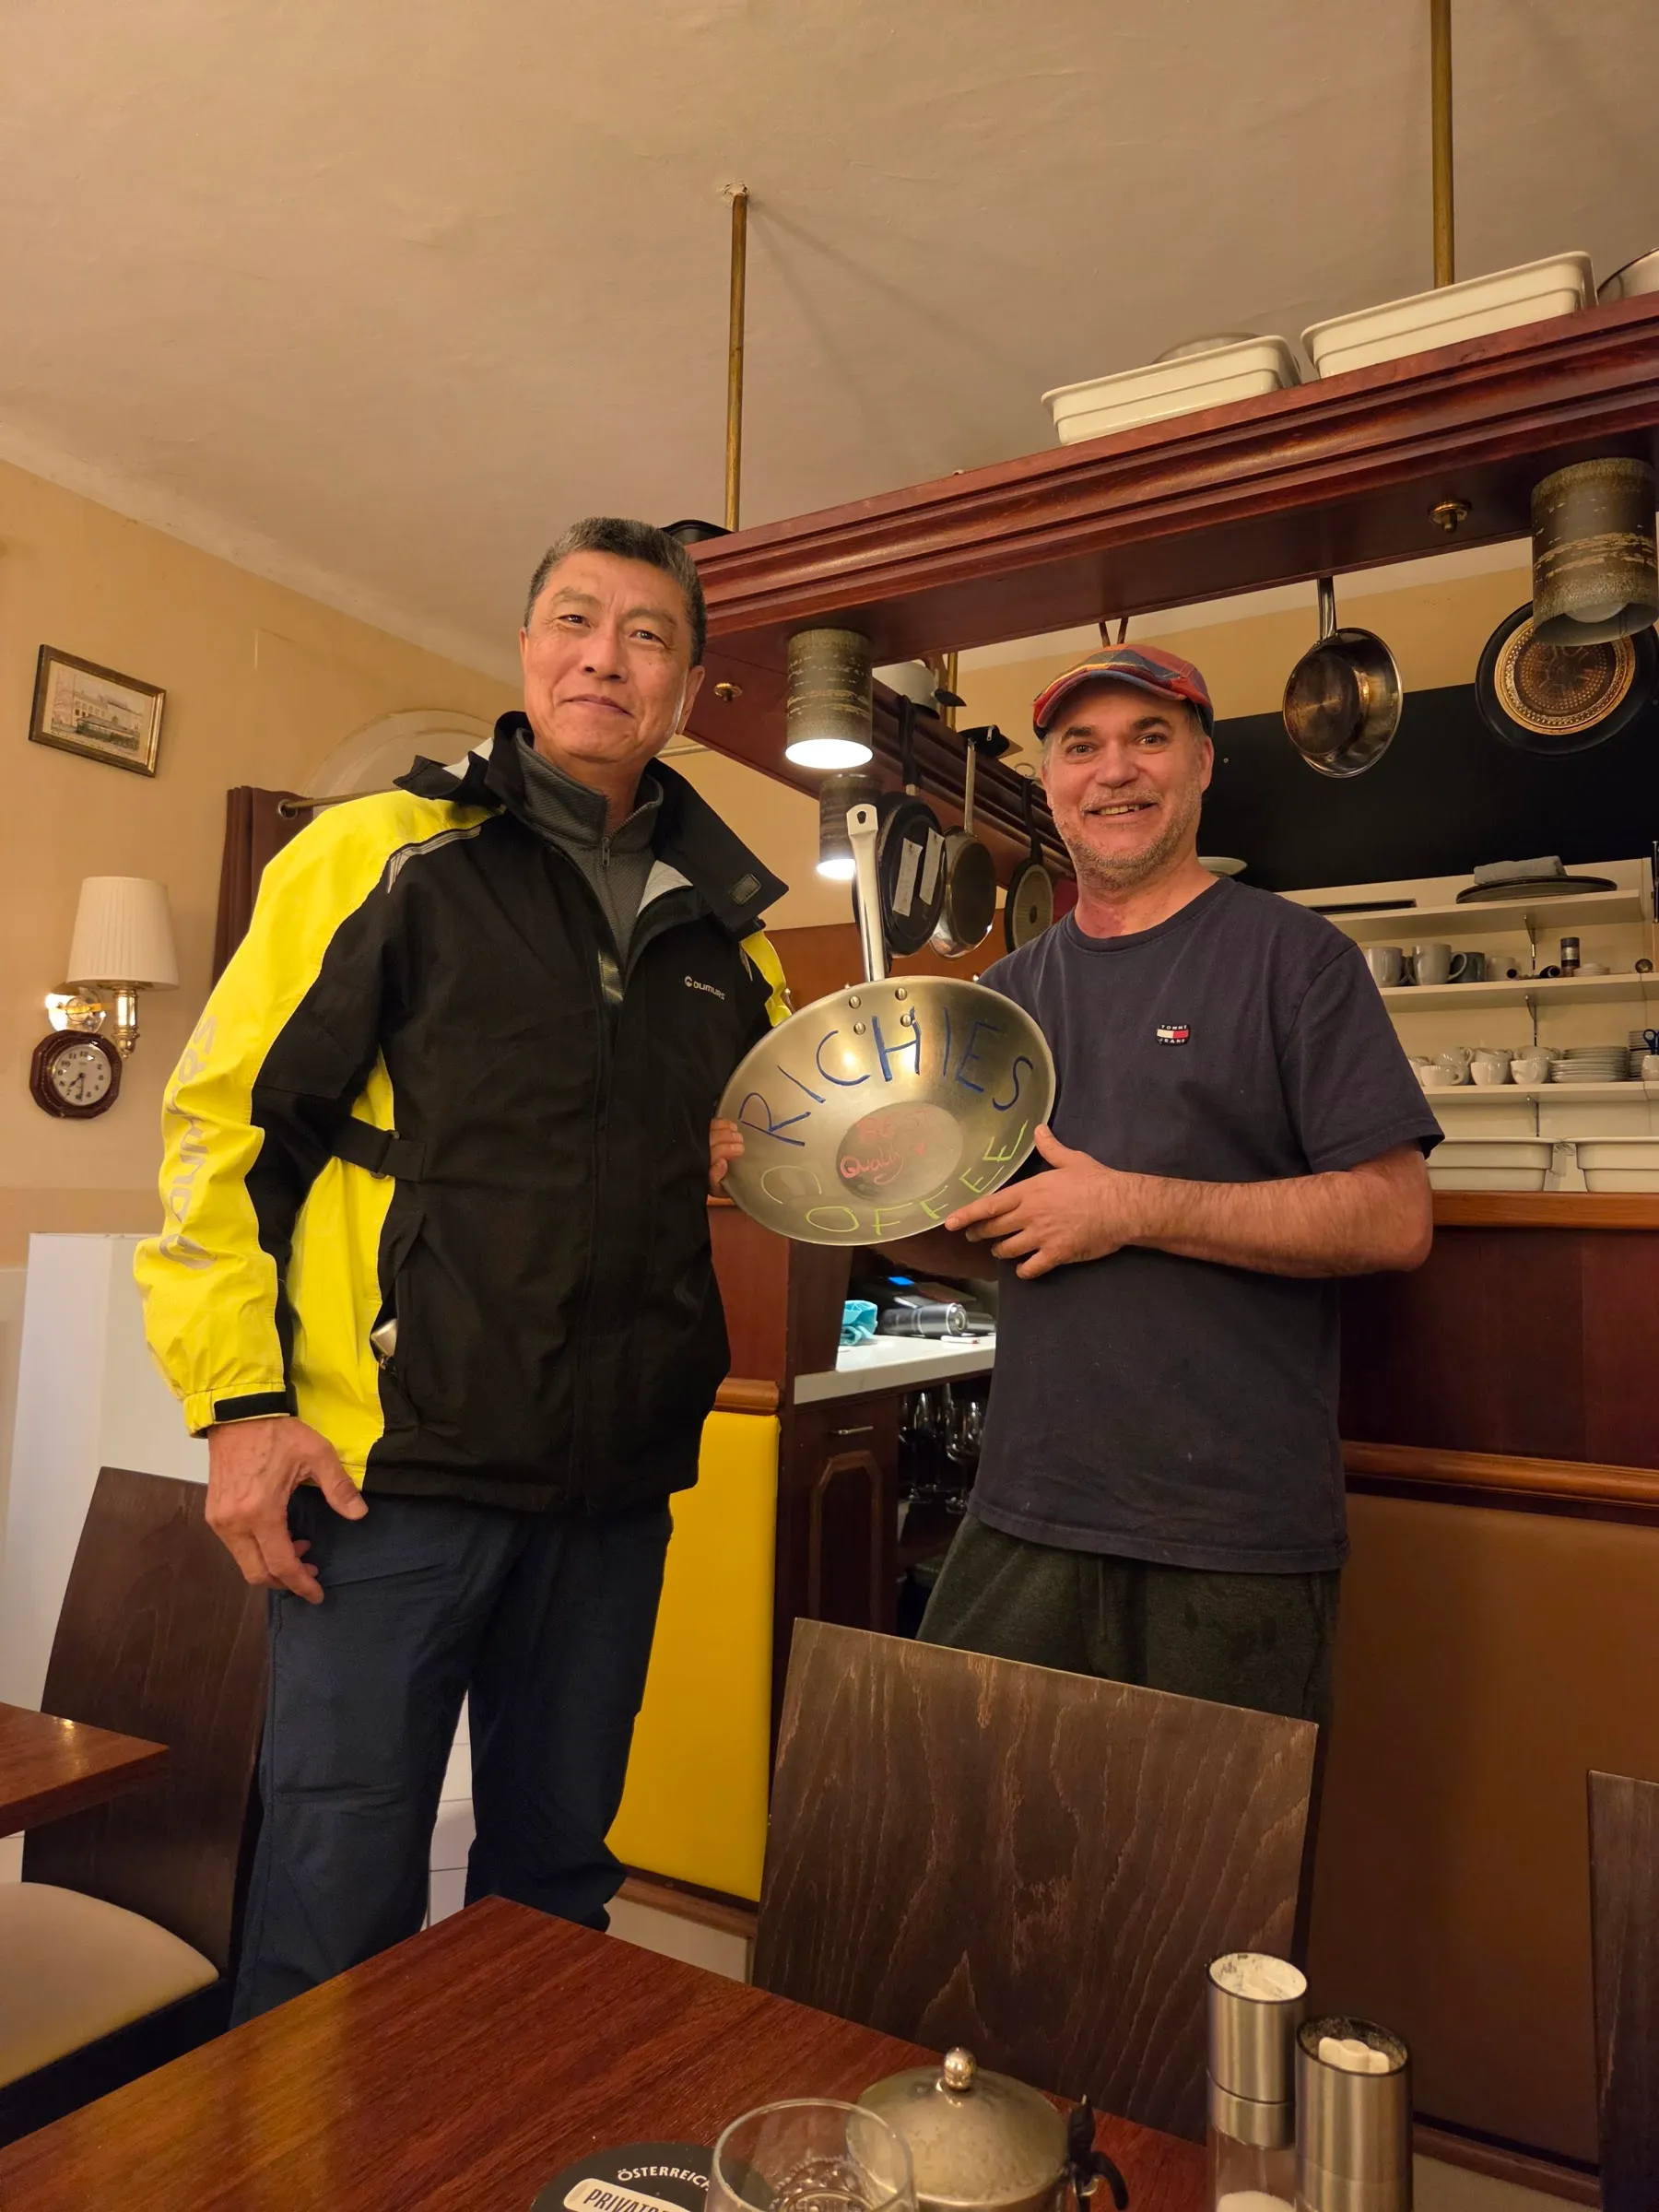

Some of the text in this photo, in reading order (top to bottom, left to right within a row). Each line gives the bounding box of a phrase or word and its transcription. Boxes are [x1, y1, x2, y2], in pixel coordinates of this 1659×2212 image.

[738, 1006, 1034, 1147] RICHIES
[760, 1120, 1029, 1235] COFFEE
[840, 1143, 905, 1186] Quality
[582, 2188, 671, 2212] PRIVAT
